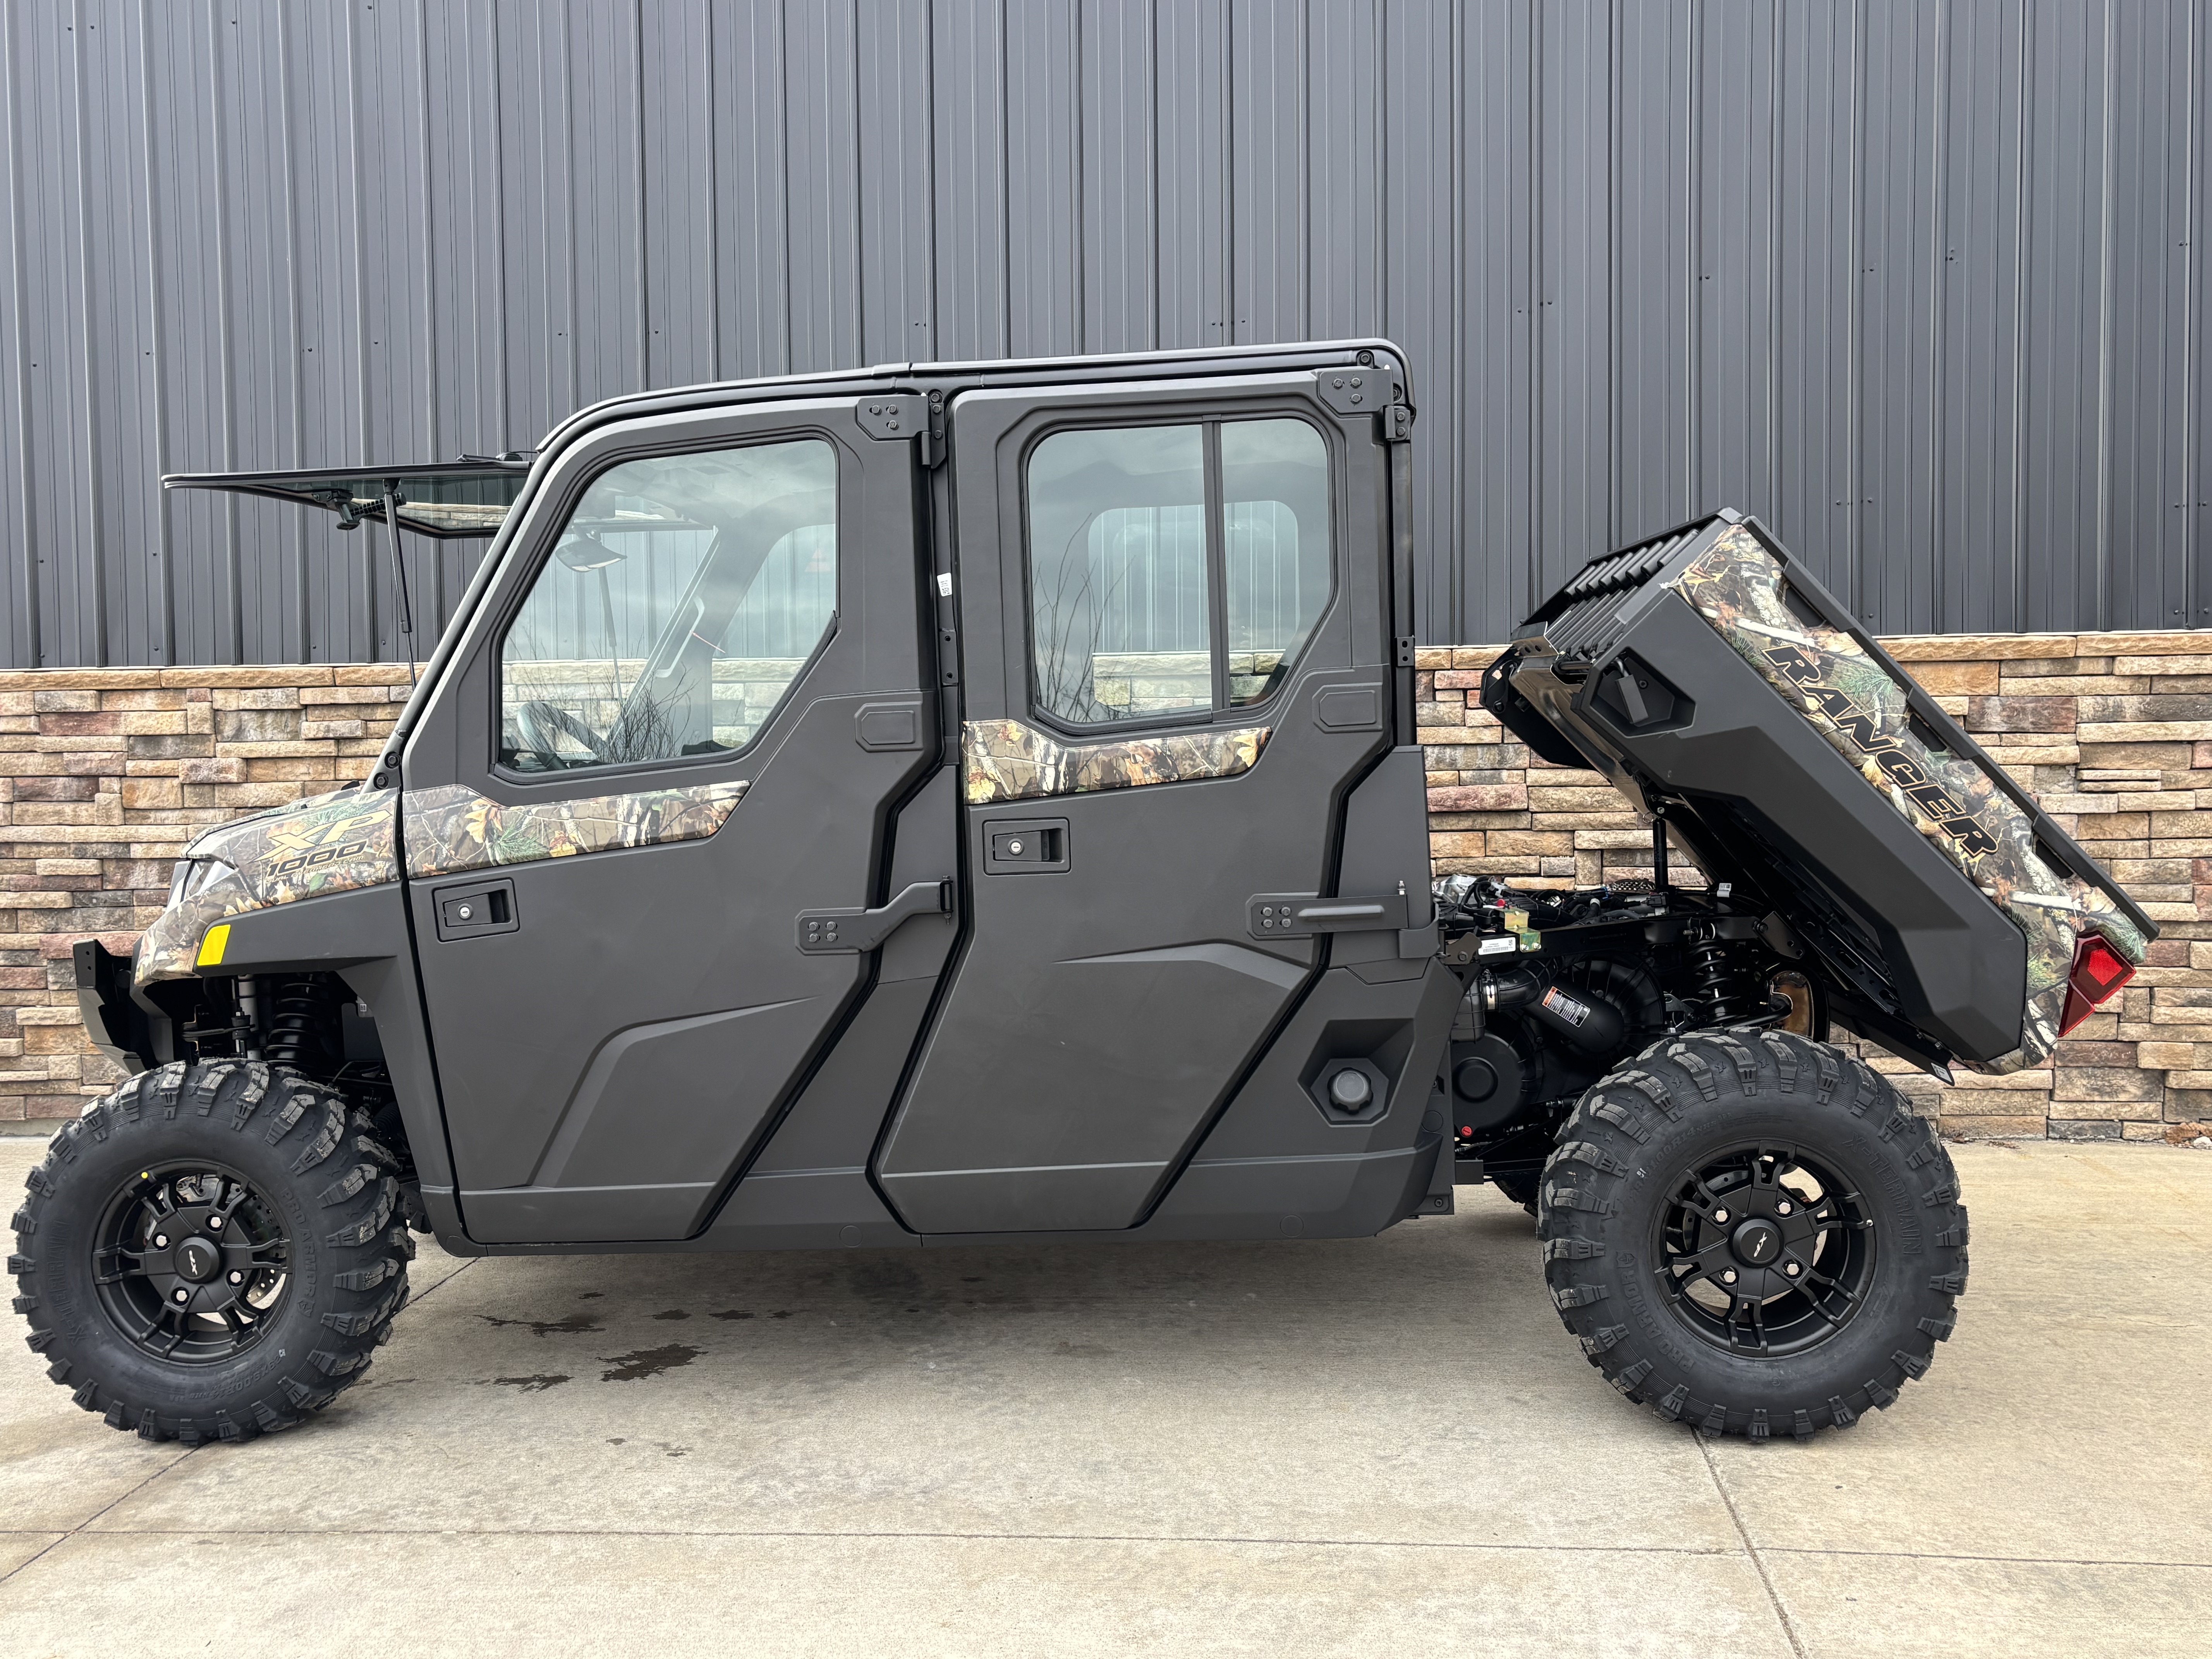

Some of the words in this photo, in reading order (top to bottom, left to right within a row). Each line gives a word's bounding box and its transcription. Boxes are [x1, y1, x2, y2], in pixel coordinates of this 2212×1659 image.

[1761, 643, 1998, 857] RANGER
[247, 809, 392, 864] XP
[265, 838, 368, 879] 1000
[343, 855, 364, 864] CAM
[1842, 1131, 1922, 1255] X-TERRAIN
[280, 1187, 306, 1224] PRO
[298, 1229, 318, 1297] ARMOR
[1753, 1231, 1767, 1257] XP
[46, 1220, 89, 1347] X-TERRAIN
[1621, 1269, 1662, 1340] ARMOR
[1657, 1338, 1695, 1374] PRO
